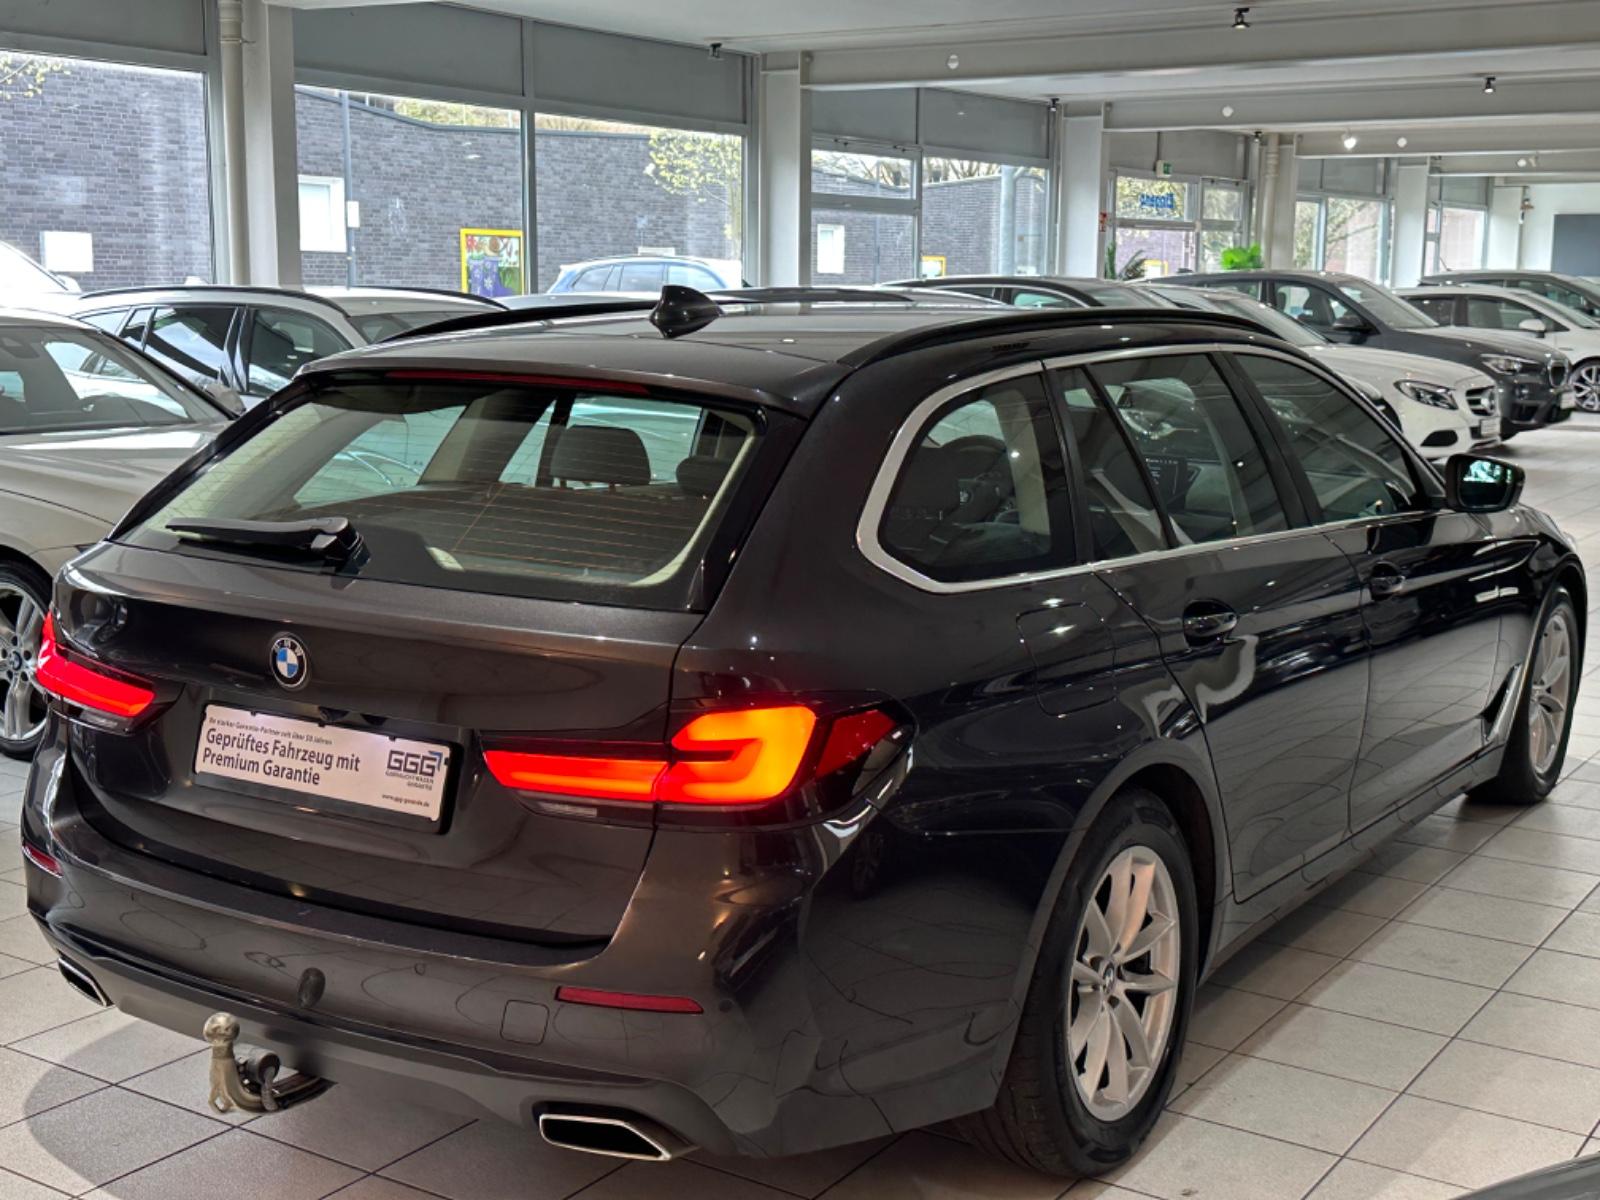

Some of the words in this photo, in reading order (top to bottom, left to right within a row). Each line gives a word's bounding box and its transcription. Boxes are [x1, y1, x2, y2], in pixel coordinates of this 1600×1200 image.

[202, 747, 260, 773] Premium
[263, 760, 320, 785] Garantie
[206, 727, 269, 755] Geprüftes
[272, 740, 334, 770] Fahrzeug
[336, 753, 361, 771] mit
[387, 750, 437, 777] GGG
